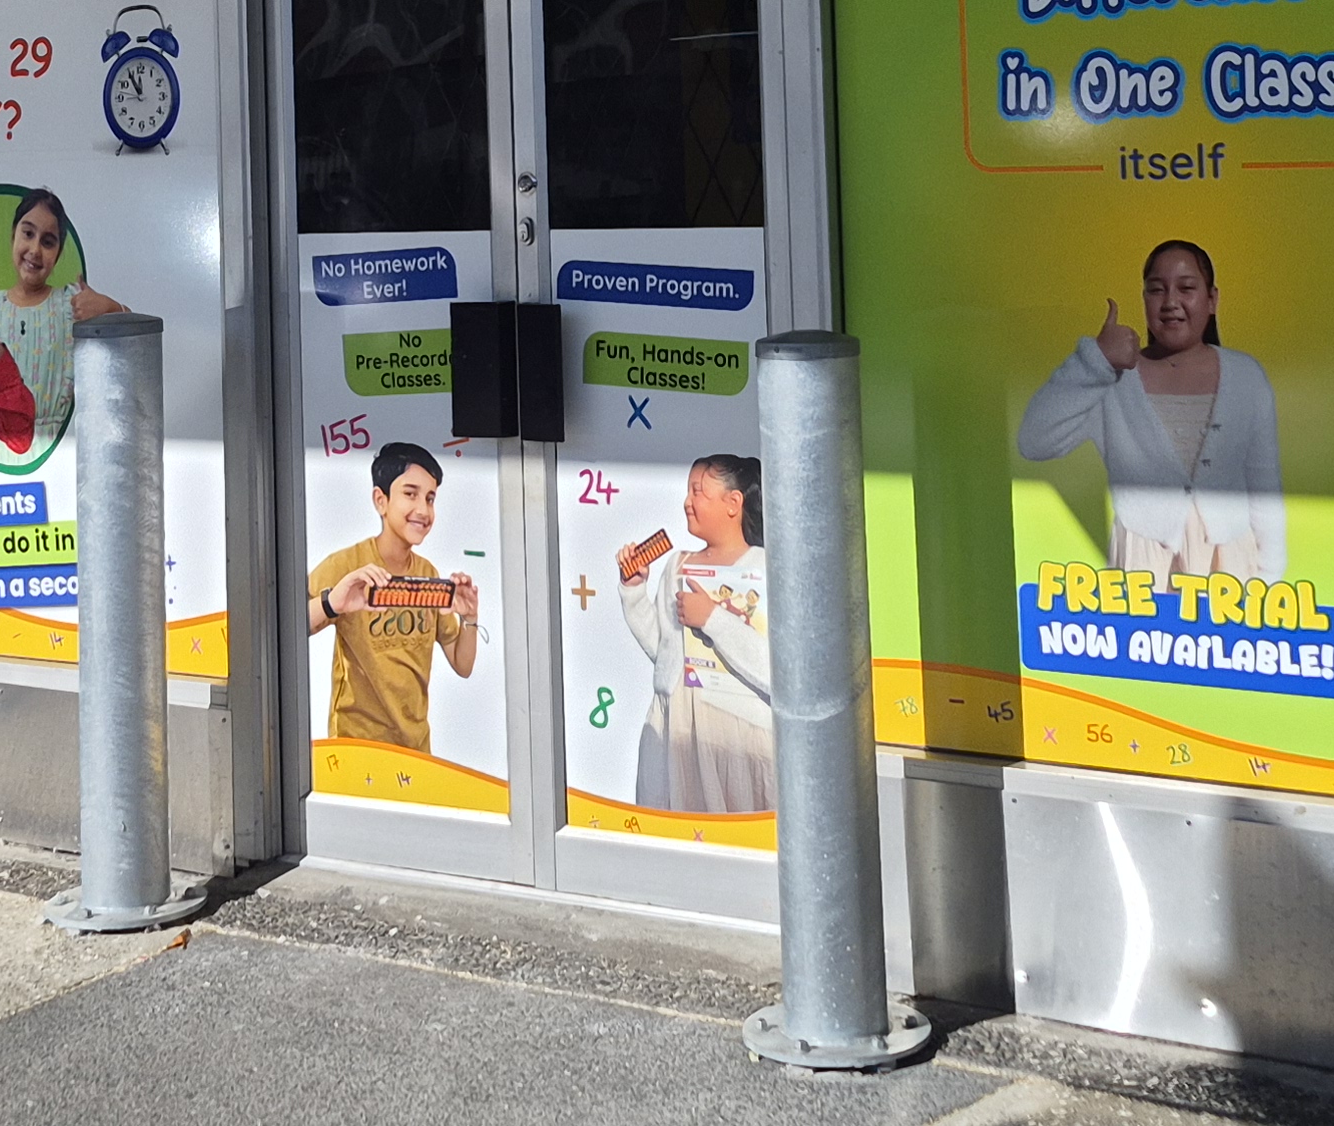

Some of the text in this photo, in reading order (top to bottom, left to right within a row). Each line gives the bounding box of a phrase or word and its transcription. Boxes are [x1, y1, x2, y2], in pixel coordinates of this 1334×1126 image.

[9, 36, 54, 79] 29
[1004, 55, 1048, 113] in
[1078, 55, 1177, 116] One
[1119, 143, 1225, 180] itself
[321, 251, 448, 278] No Homework
[362, 280, 407, 300] Ever!
[571, 269, 740, 300] Proven Program.
[399, 332, 422, 349] No
[595, 340, 740, 369] Fun, Hands-on
[355, 349, 452, 371] Pre-Record
[380, 371, 446, 389] Classes.
[626, 365, 706, 391] Classes!
[320, 413, 371, 458] 155
[578, 469, 620, 505] 24
[4, 530, 29, 554] do
[35, 529, 50, 552] it
[54, 527, 75, 551] in
[9, 580, 25, 597] a
[28, 577, 79, 597] seco
[1037, 561, 1157, 617] FREE
[49, 632, 65, 650] 14
[1038, 621, 1118, 660] NOW
[589, 687, 615, 729] 8
[987, 701, 1014, 722] 45
[1086, 724, 1113, 743] 56
[1167, 743, 1191, 765] 28
[1248, 756, 1271, 777] 14
[396, 771, 411, 788] 14
